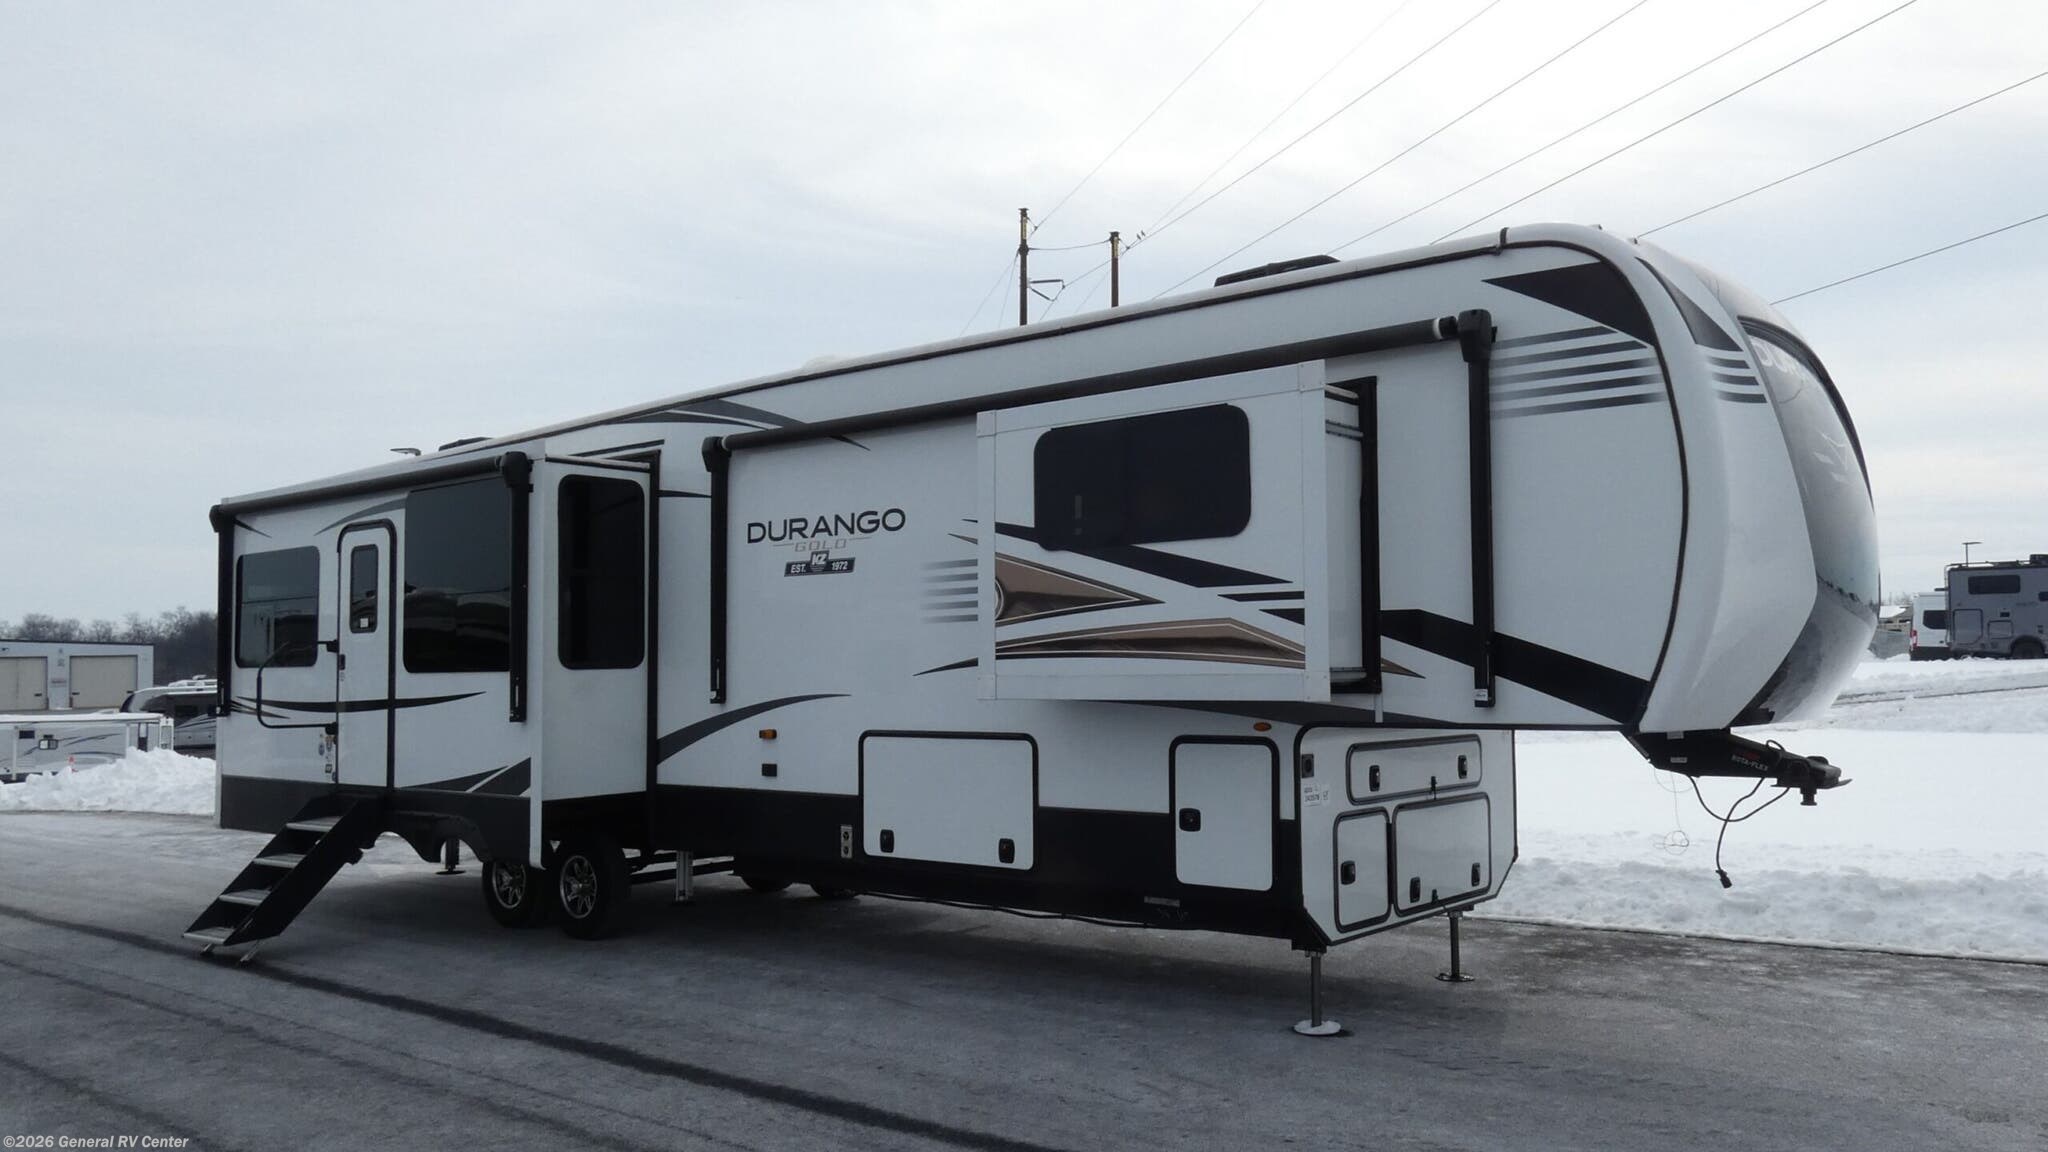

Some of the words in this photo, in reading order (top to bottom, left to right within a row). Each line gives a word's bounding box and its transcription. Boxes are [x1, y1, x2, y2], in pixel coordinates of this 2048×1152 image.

[747, 508, 906, 544] DURANGO
[795, 538, 847, 552] GOLD
[790, 563, 807, 573] EST.
[831, 561, 849, 571] 1972
